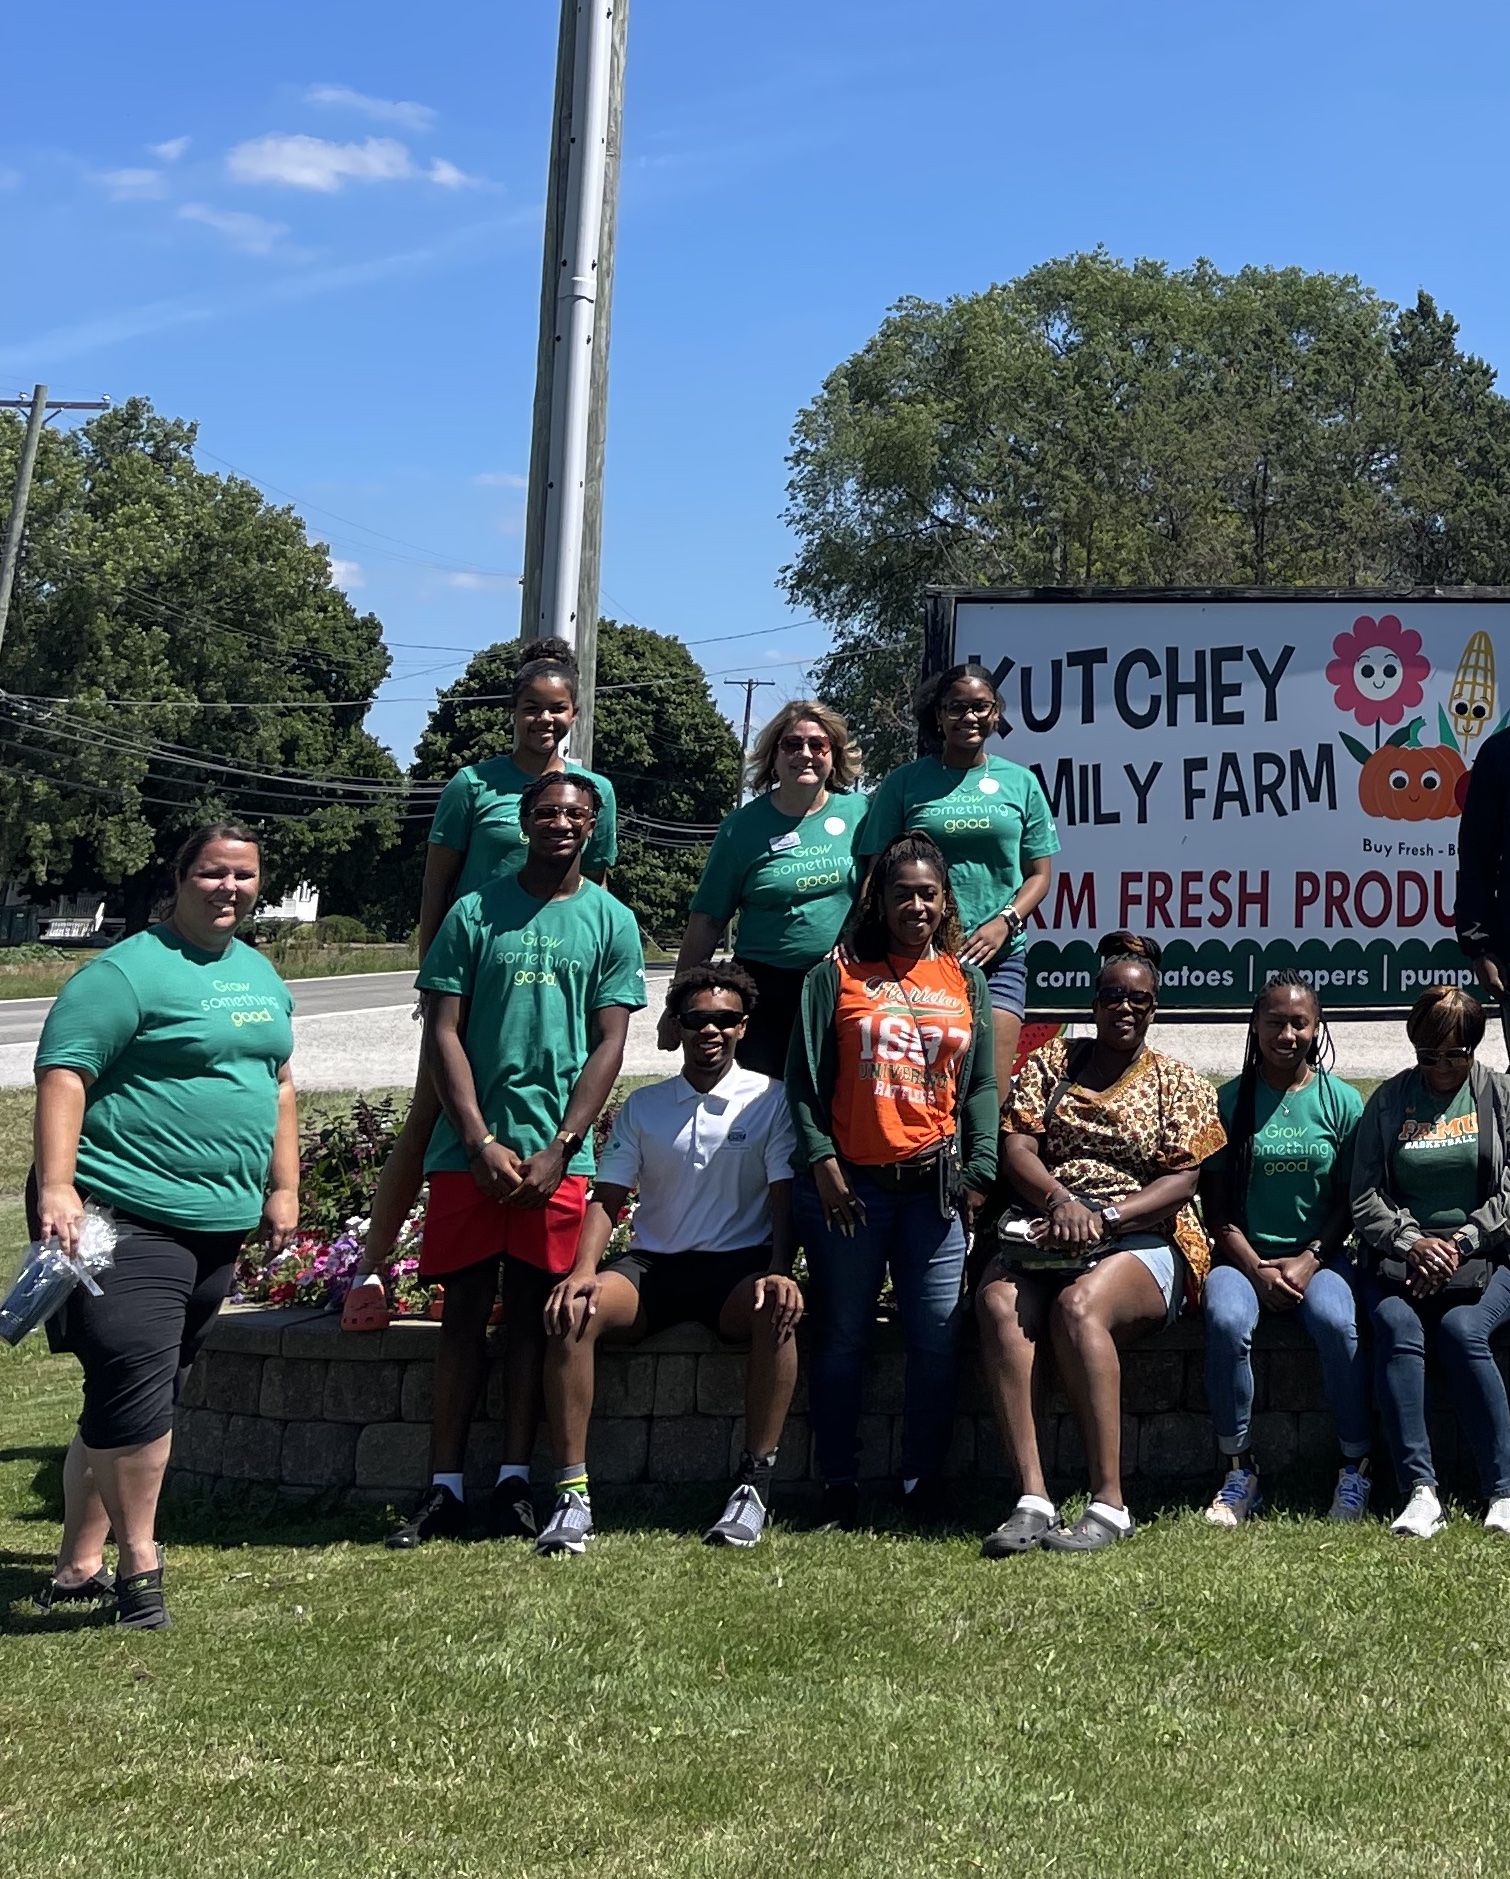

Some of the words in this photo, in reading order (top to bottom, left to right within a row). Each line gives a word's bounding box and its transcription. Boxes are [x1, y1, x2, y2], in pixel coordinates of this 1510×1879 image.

[1029, 756, 1164, 826] MILY
[1183, 743, 1338, 821] FARM
[791, 843, 833, 858] Grow
[1362, 838, 1393, 857] Buy
[1398, 842, 1434, 856] Fresh
[1119, 870, 1270, 929] FRESH
[1295, 869, 1459, 929] PRODU
[521, 930, 565, 949] Grow
[496, 951, 582, 975] something
[212, 979, 250, 993] Grow
[1036, 969, 1091, 988] corn
[200, 993, 280, 1012] something
[1264, 1123, 1309, 1139] Grow
[1398, 1111, 1479, 1141] FAMU
[1252, 1140, 1330, 1158] omething
[1404, 1134, 1477, 1150] BASKETBALL
